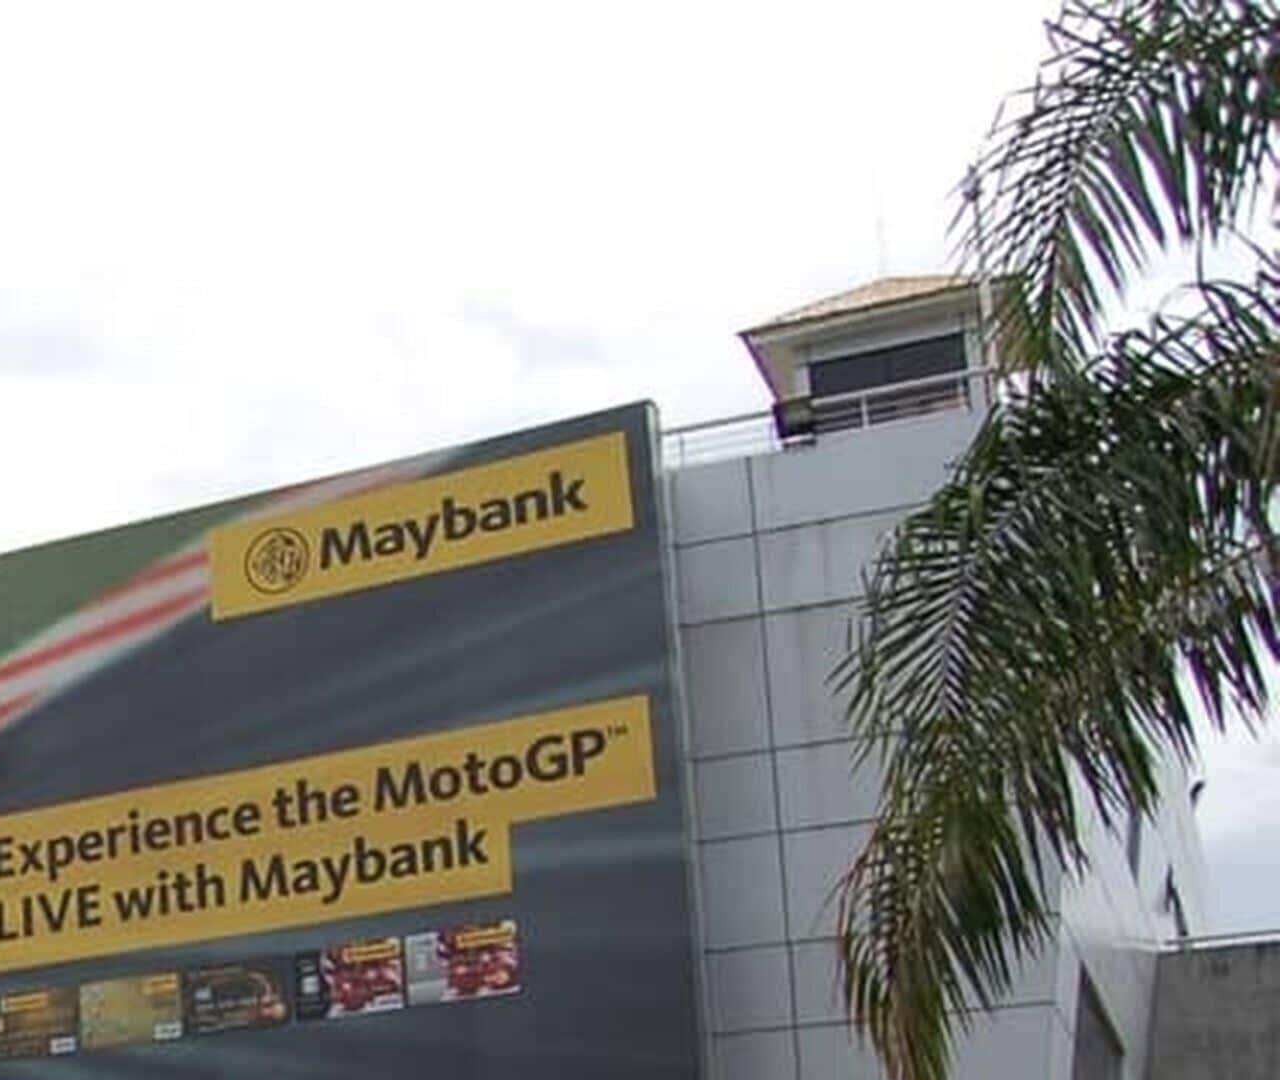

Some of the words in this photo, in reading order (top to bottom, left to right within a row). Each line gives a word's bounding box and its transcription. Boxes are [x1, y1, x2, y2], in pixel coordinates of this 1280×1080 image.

[319, 471, 588, 570] Maybank
[273, 779, 359, 829] the
[115, 872, 225, 920] with
[239, 819, 489, 905] Maybank
